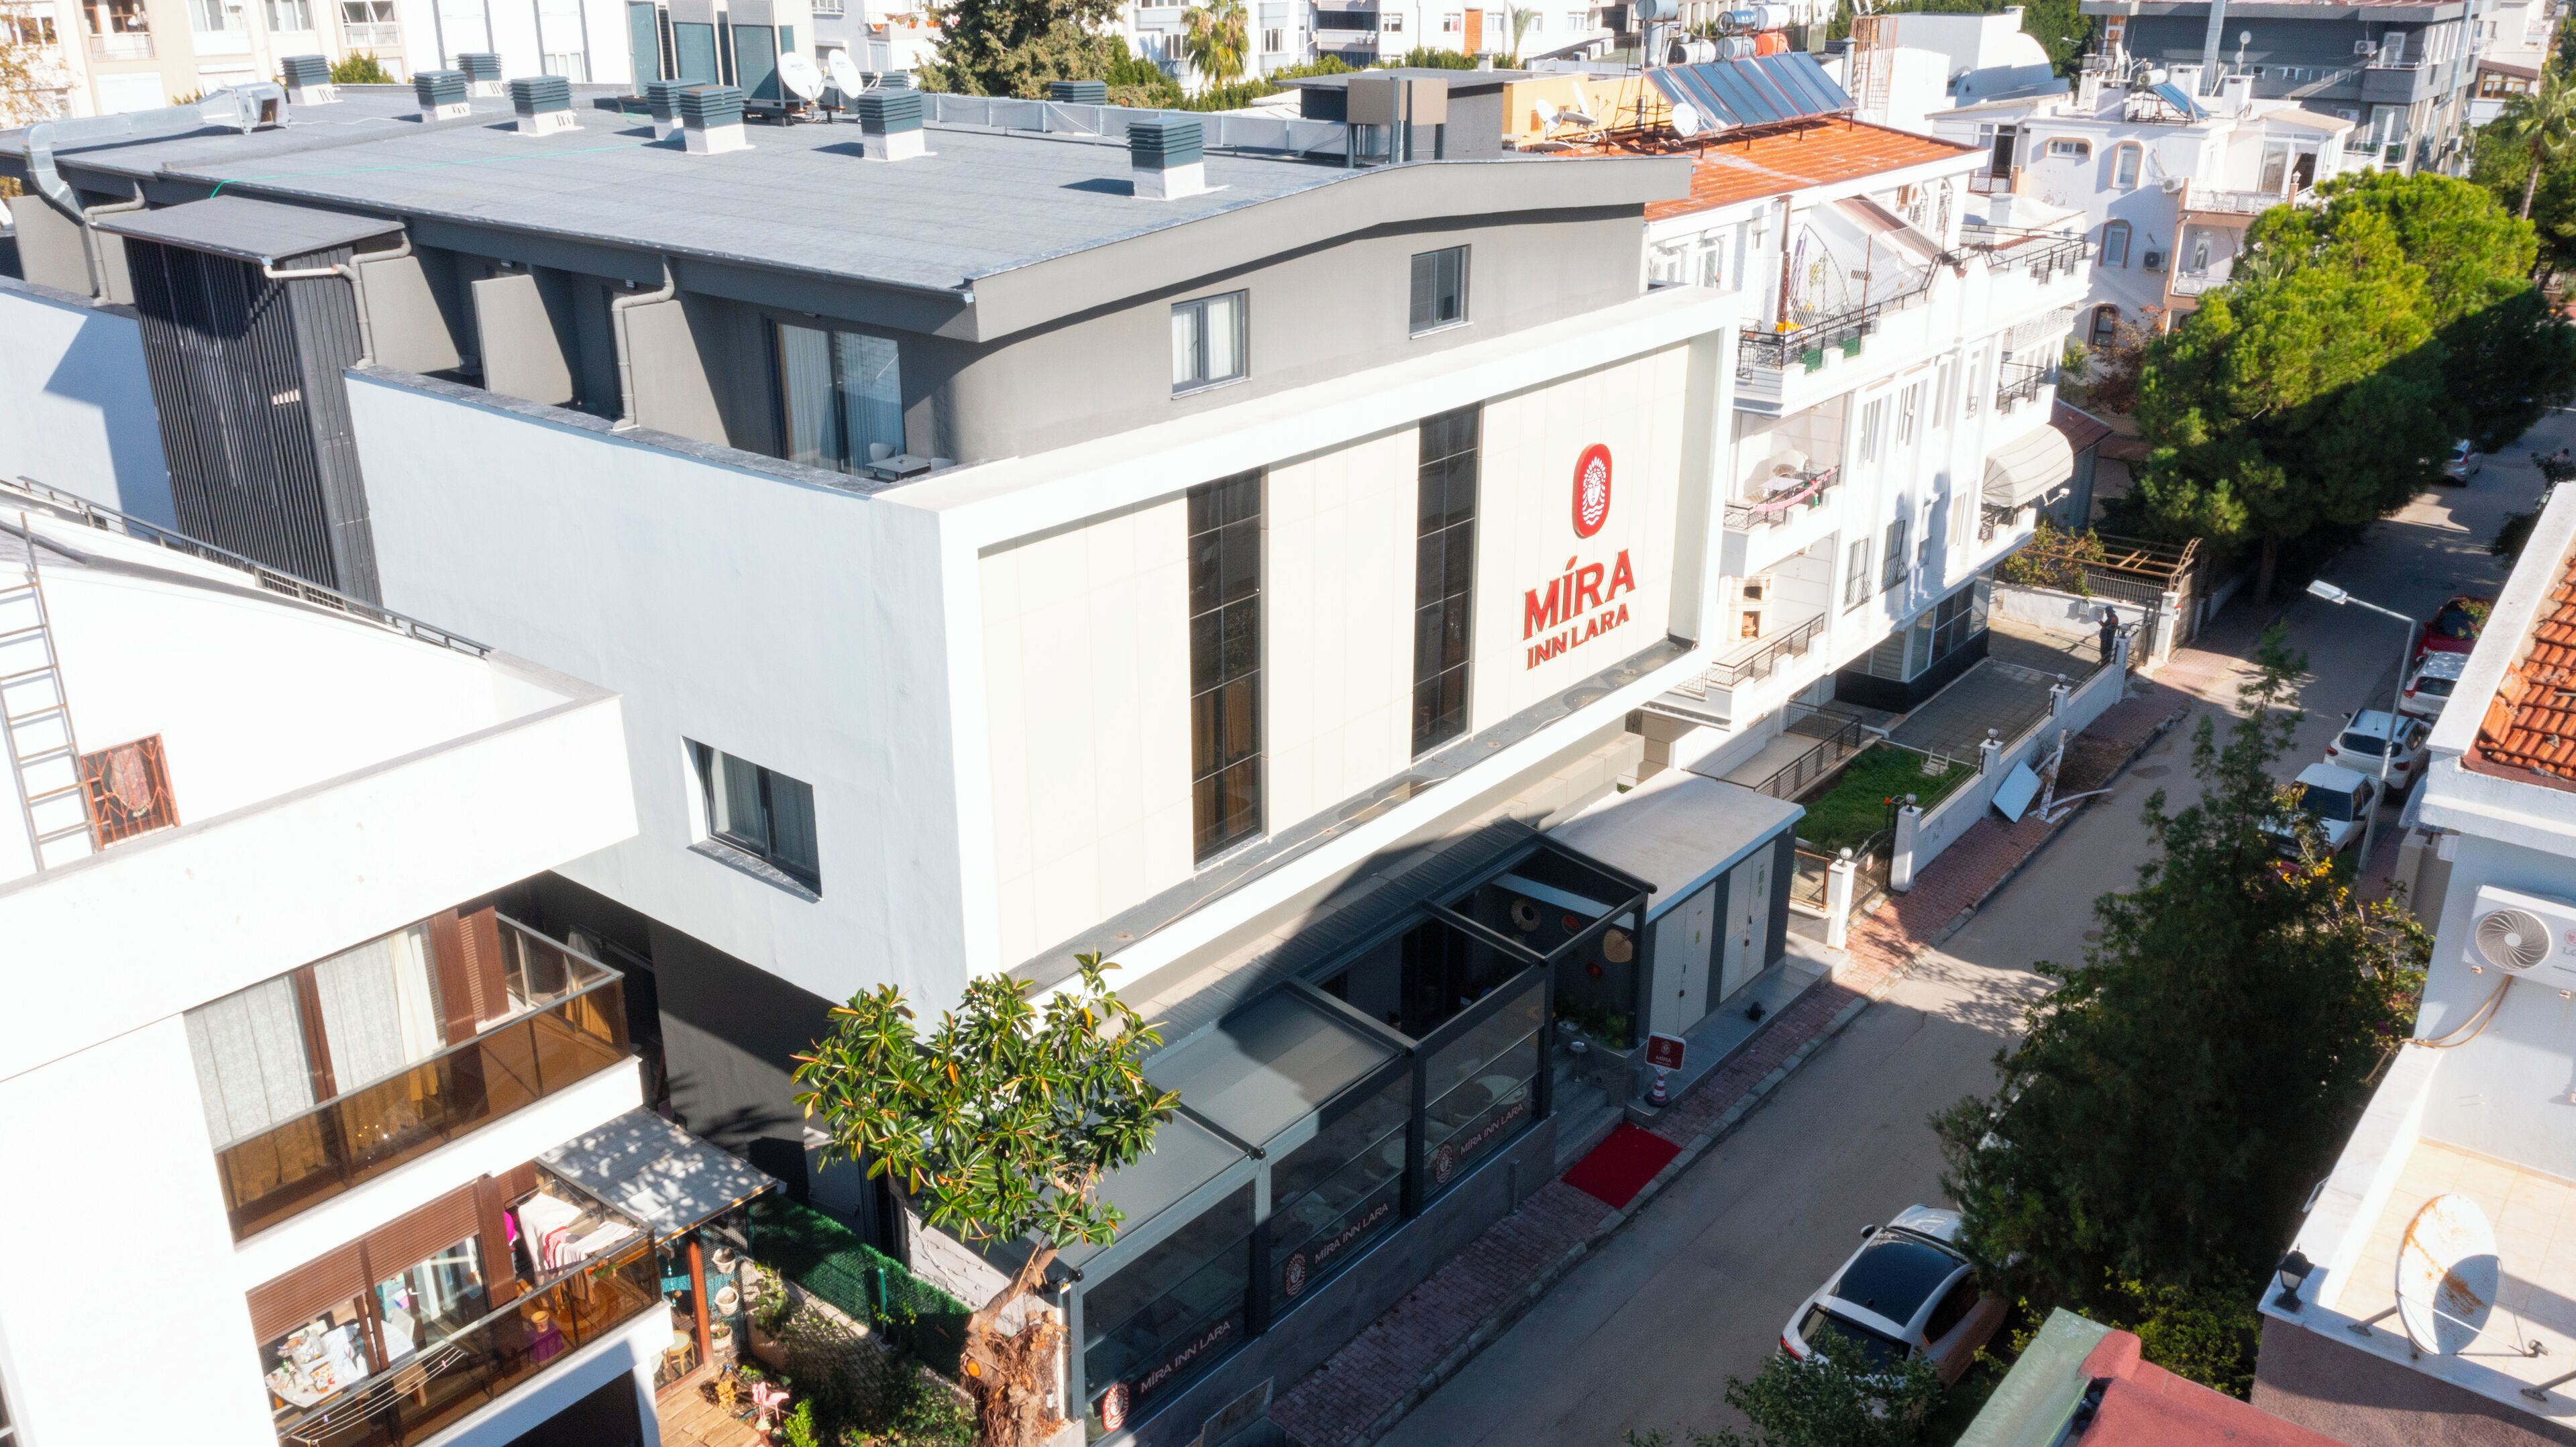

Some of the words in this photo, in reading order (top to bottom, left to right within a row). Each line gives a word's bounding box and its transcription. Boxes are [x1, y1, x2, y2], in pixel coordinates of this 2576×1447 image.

[1526, 631, 1567, 671] INN
[1570, 603, 1629, 649] LARA
[1484, 1119, 1499, 1138] INN
[1501, 1103, 1523, 1125] LARA
[1342, 1223, 1361, 1243] INN
[1362, 1203, 1389, 1228] LARA
[1175, 1344, 1197, 1368] INN
[1199, 1320, 1231, 1350] LARA
